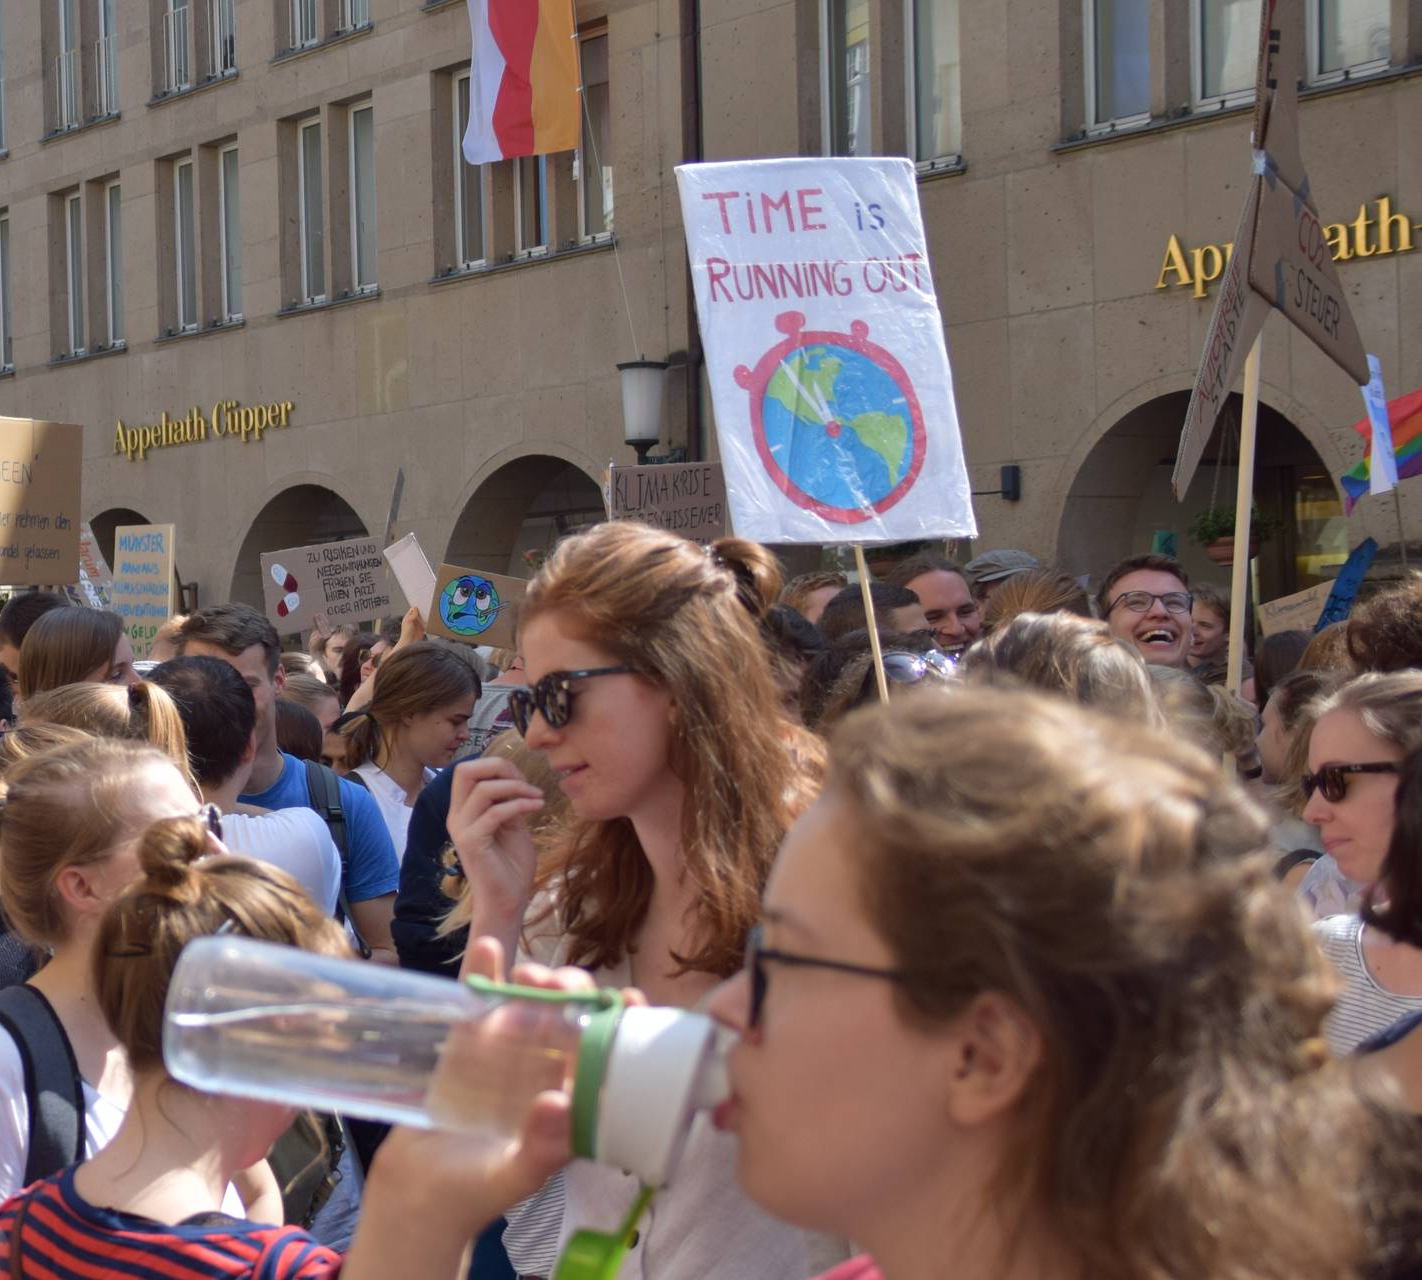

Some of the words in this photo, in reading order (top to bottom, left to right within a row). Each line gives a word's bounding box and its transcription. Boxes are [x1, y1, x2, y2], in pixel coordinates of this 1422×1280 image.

[862, 253, 925, 294] OUT
[1294, 267, 1340, 341] STEUER
[211, 399, 295, 442] Cüpper
[306, 552, 321, 564] ZU
[322, 543, 360, 562] RISIKEN
[353, 583, 376, 598] ARZT
[326, 602, 353, 616] ODER
